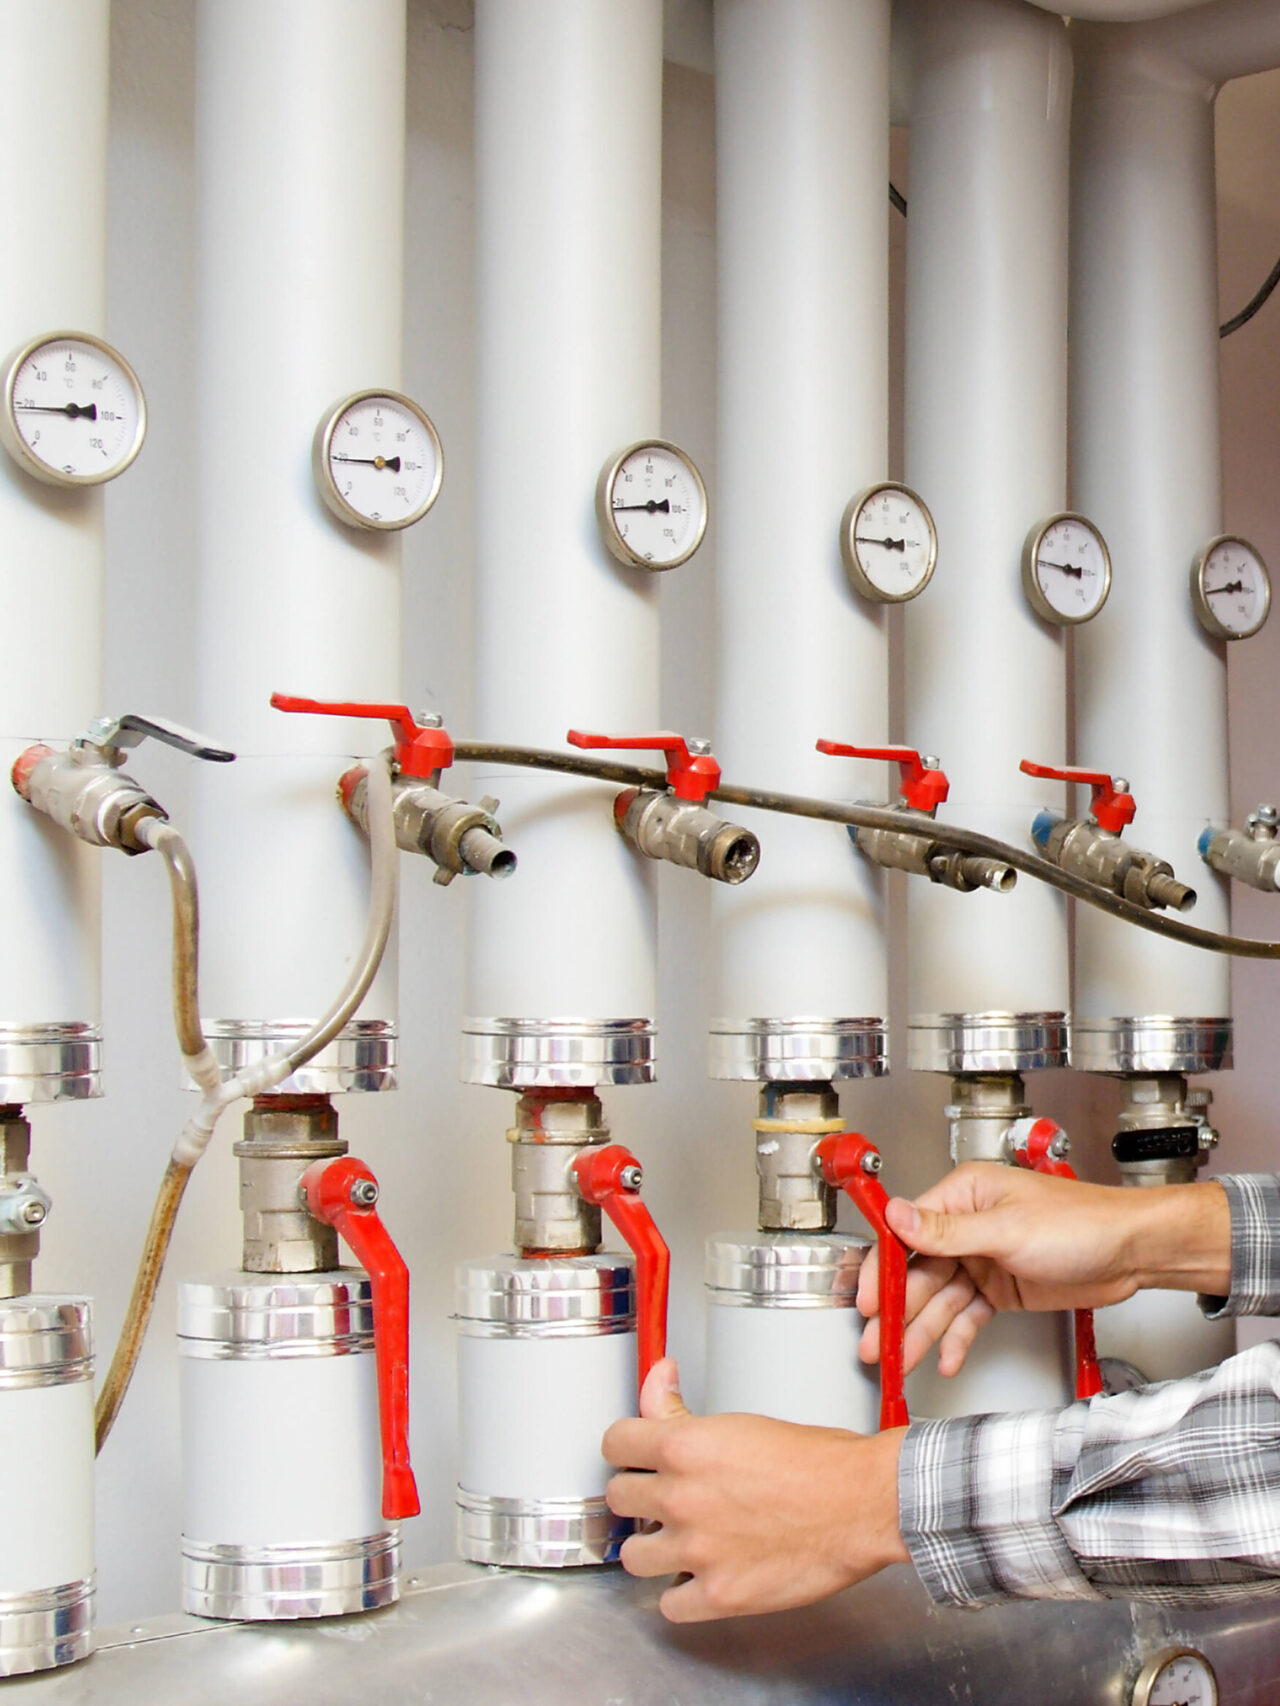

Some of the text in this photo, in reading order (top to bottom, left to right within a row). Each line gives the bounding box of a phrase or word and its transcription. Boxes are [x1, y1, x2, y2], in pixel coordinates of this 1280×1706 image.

[36, 371, 47, 382] 40
[100, 411, 115, 422] 100
[89, 438, 103, 449] 120
